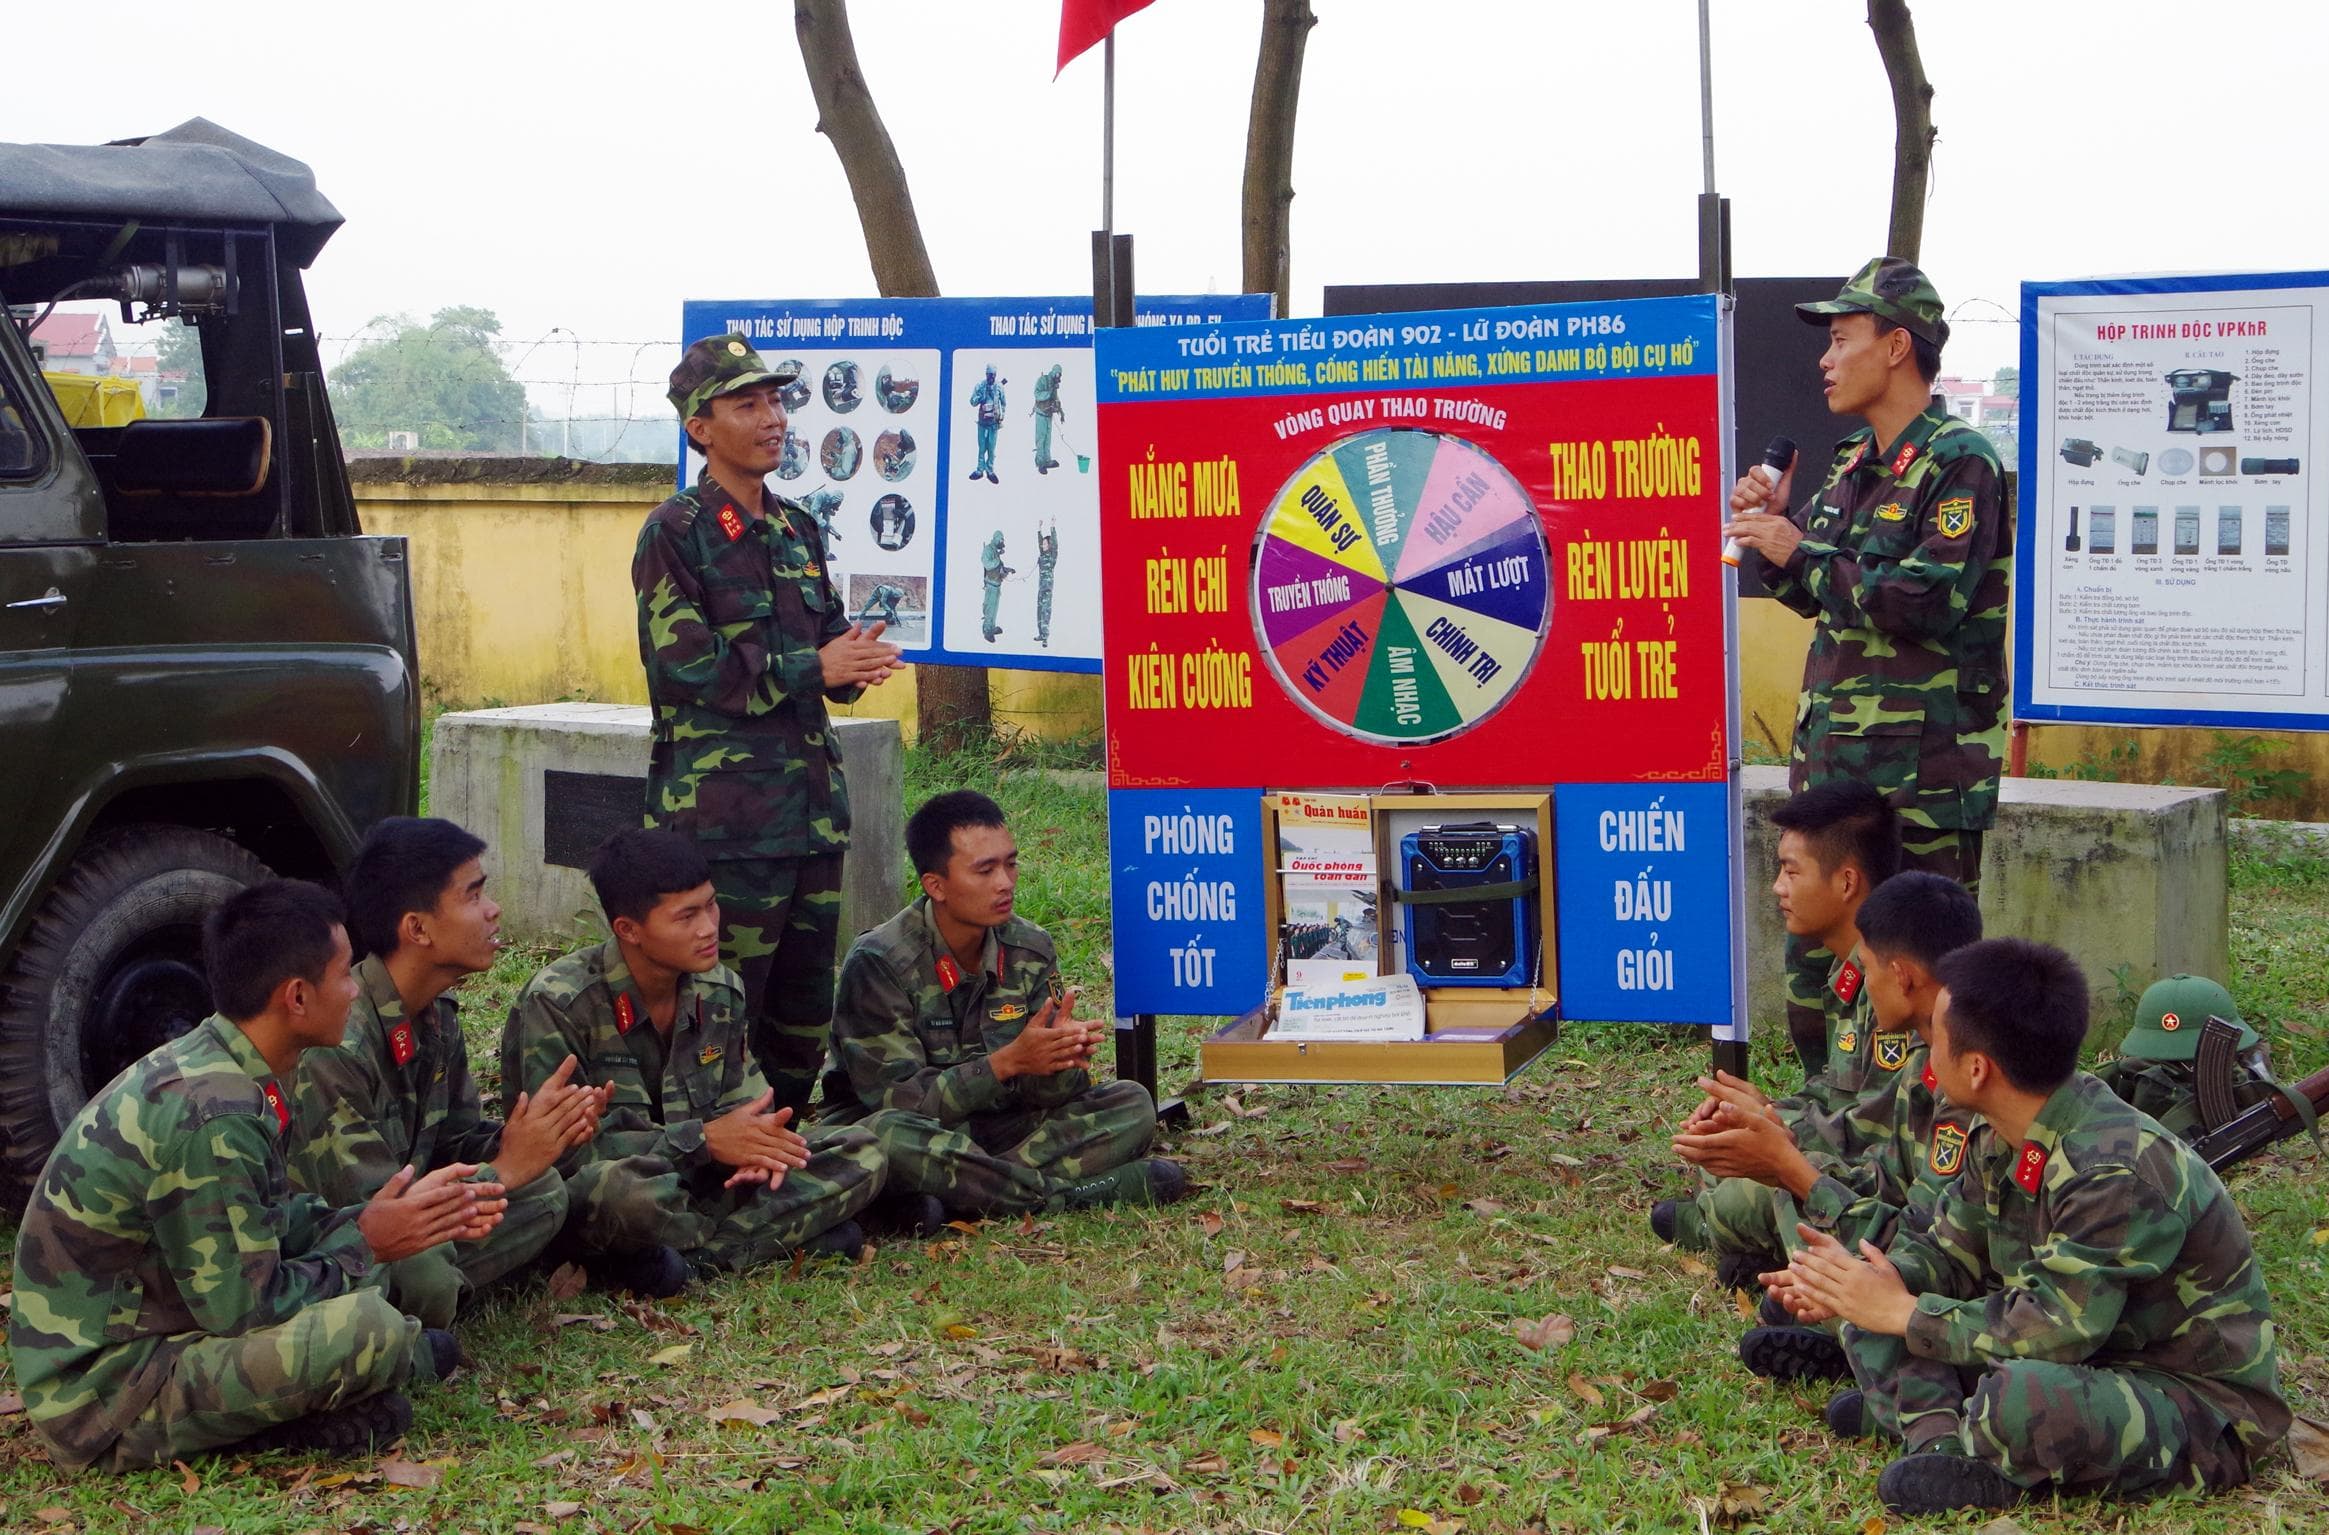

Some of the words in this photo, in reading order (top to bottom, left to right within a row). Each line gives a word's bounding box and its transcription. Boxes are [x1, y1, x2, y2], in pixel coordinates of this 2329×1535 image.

[726, 319, 751, 338] THAO
[754, 315, 774, 338] TÁC
[776, 311, 792, 338] SỬ
[793, 318, 821, 341] DỤNG
[823, 314, 846, 341] HỘP
[848, 317, 879, 337] TRINH
[881, 313, 904, 341] ĐỘC
[990, 315, 1016, 336] THAO
[1018, 312, 1038, 336] TÁC
[1040, 307, 1057, 335] SỬ
[1057, 315, 1086, 339] DỤNG
[1178, 329, 1226, 356] TUỔI
[1233, 328, 1274, 355] TRẺ
[1279, 324, 1326, 352] TIỂU
[1332, 324, 1394, 349] ĐOÀN
[1401, 325, 1442, 345] 902
[1463, 318, 1488, 342] LỮ
[1496, 315, 1559, 340] ĐOÀN
[1567, 314, 1626, 338] PH86
[2097, 322, 2126, 343] HỘP
[2132, 323, 2177, 339] TRINH
[2182, 320, 2211, 341] ĐỘC
[2217, 321, 2268, 337] VPKhR
[1160, 369, 1190, 391] HUY
[1193, 359, 1252, 389] TRUYỀN
[1256, 356, 1312, 387] THỐNG,
[1315, 354, 1358, 384] CỐNG
[1363, 351, 1400, 381] HIẾN
[1404, 353, 1428, 379] TÀI
[1433, 351, 1483, 378] NĂNG,
[1487, 346, 1531, 375] XỨNG
[1536, 350, 1580, 373] DANH
[1585, 343, 1607, 375] BỘ
[1611, 341, 1639, 373] ĐỘI
[1644, 344, 1666, 372] CỤ
[1273, 408, 1324, 440] VÒNG
[1328, 399, 1375, 426] QUAY
[1380, 397, 1428, 418] THAO
[1433, 398, 1507, 431] TRƯỜNG
[1129, 443, 1188, 519] NẮNG
[1192, 454, 1241, 518] MƯA
[1550, 440, 1607, 500] THAO
[1612, 421, 1701, 499] TRƯỜNG
[1301, 484, 1342, 533] QUÂN
[1330, 522, 1362, 555] SỰ
[1370, 484, 1406, 547] THƯỞNG
[1423, 503, 1462, 546] HẬU
[1146, 546, 1188, 614] RÈN
[1193, 544, 1228, 614] CHÍ
[1267, 574, 1312, 613] TRUYỀN
[1311, 568, 1351, 606] THỐNG
[1447, 557, 1484, 598] MẤT
[1487, 555, 1530, 591] LƯỢT
[1567, 528, 1612, 600] RÈN
[1617, 526, 1689, 612] LUYỆN
[1320, 619, 1369, 673] THUẬT
[1387, 646, 1417, 674] ÂM
[1425, 616, 1480, 665] CHÍNH
[1467, 651, 1502, 689] TRỊ
[1581, 617, 1631, 701] TUỔI
[1637, 614, 1679, 699] TRẺ
[1128, 641, 1177, 710] KIÊN
[1181, 637, 1253, 710] CƯỜNG
[1390, 678, 1422, 726] NHẠC
[1144, 805, 1234, 855] PHÒNG
[1304, 804, 1334, 818] Quân
[1338, 805, 1368, 820] huấn
[1599, 795, 1685, 852] CHIẾN
[1146, 867, 1236, 922] CHỐNG
[1614, 865, 1672, 922] ĐẤU
[1169, 934, 1216, 988] TỐT
[1616, 931, 1674, 991] GIỎI
